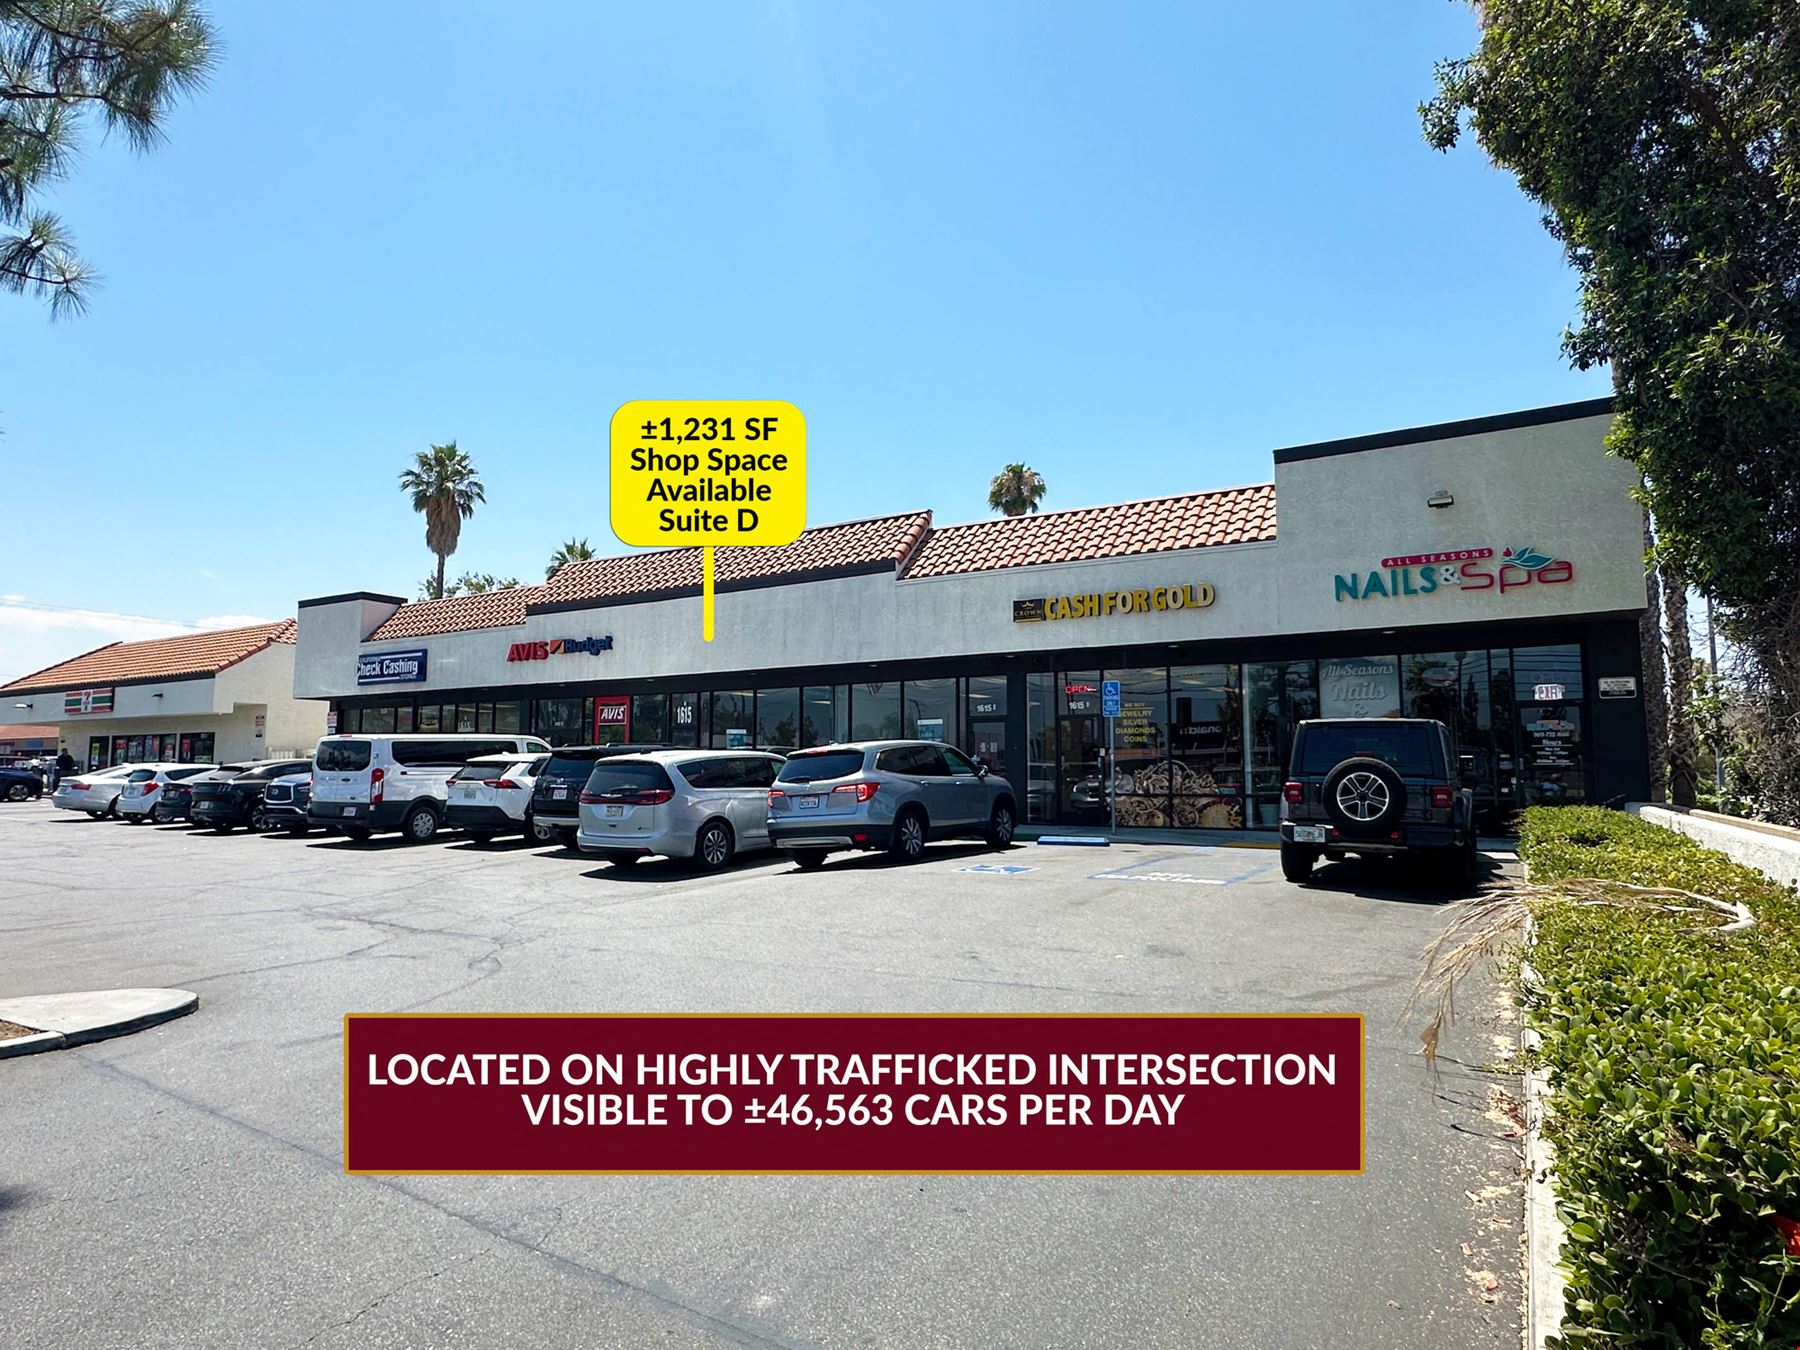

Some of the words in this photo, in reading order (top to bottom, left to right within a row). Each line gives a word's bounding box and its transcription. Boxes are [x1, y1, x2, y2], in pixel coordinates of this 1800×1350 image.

[1386, 556, 1411, 567] ALL
[1420, 549, 1491, 563] SEASONS
[1334, 565, 1438, 602] NAILS
[1460, 559, 1574, 594] Spa
[1043, 594, 1101, 620] CASH
[1103, 588, 1150, 616] FOR
[1151, 583, 1216, 611] GOLD
[1014, 609, 1043, 618] CROWN
[507, 641, 550, 662] AVIS
[562, 635, 614, 656] Budget
[356, 662, 381, 677] Check
[383, 658, 418, 675] Cashing
[1321, 665, 1340, 678] All
[1342, 664, 1394, 677] Seasons
[1065, 685, 1091, 695] OPEN
[1331, 680, 1388, 702] Nails
[600, 707, 625, 720] AVIS
[677, 705, 692, 724] 1615
[1115, 727, 1156, 735] DIAMONDS
